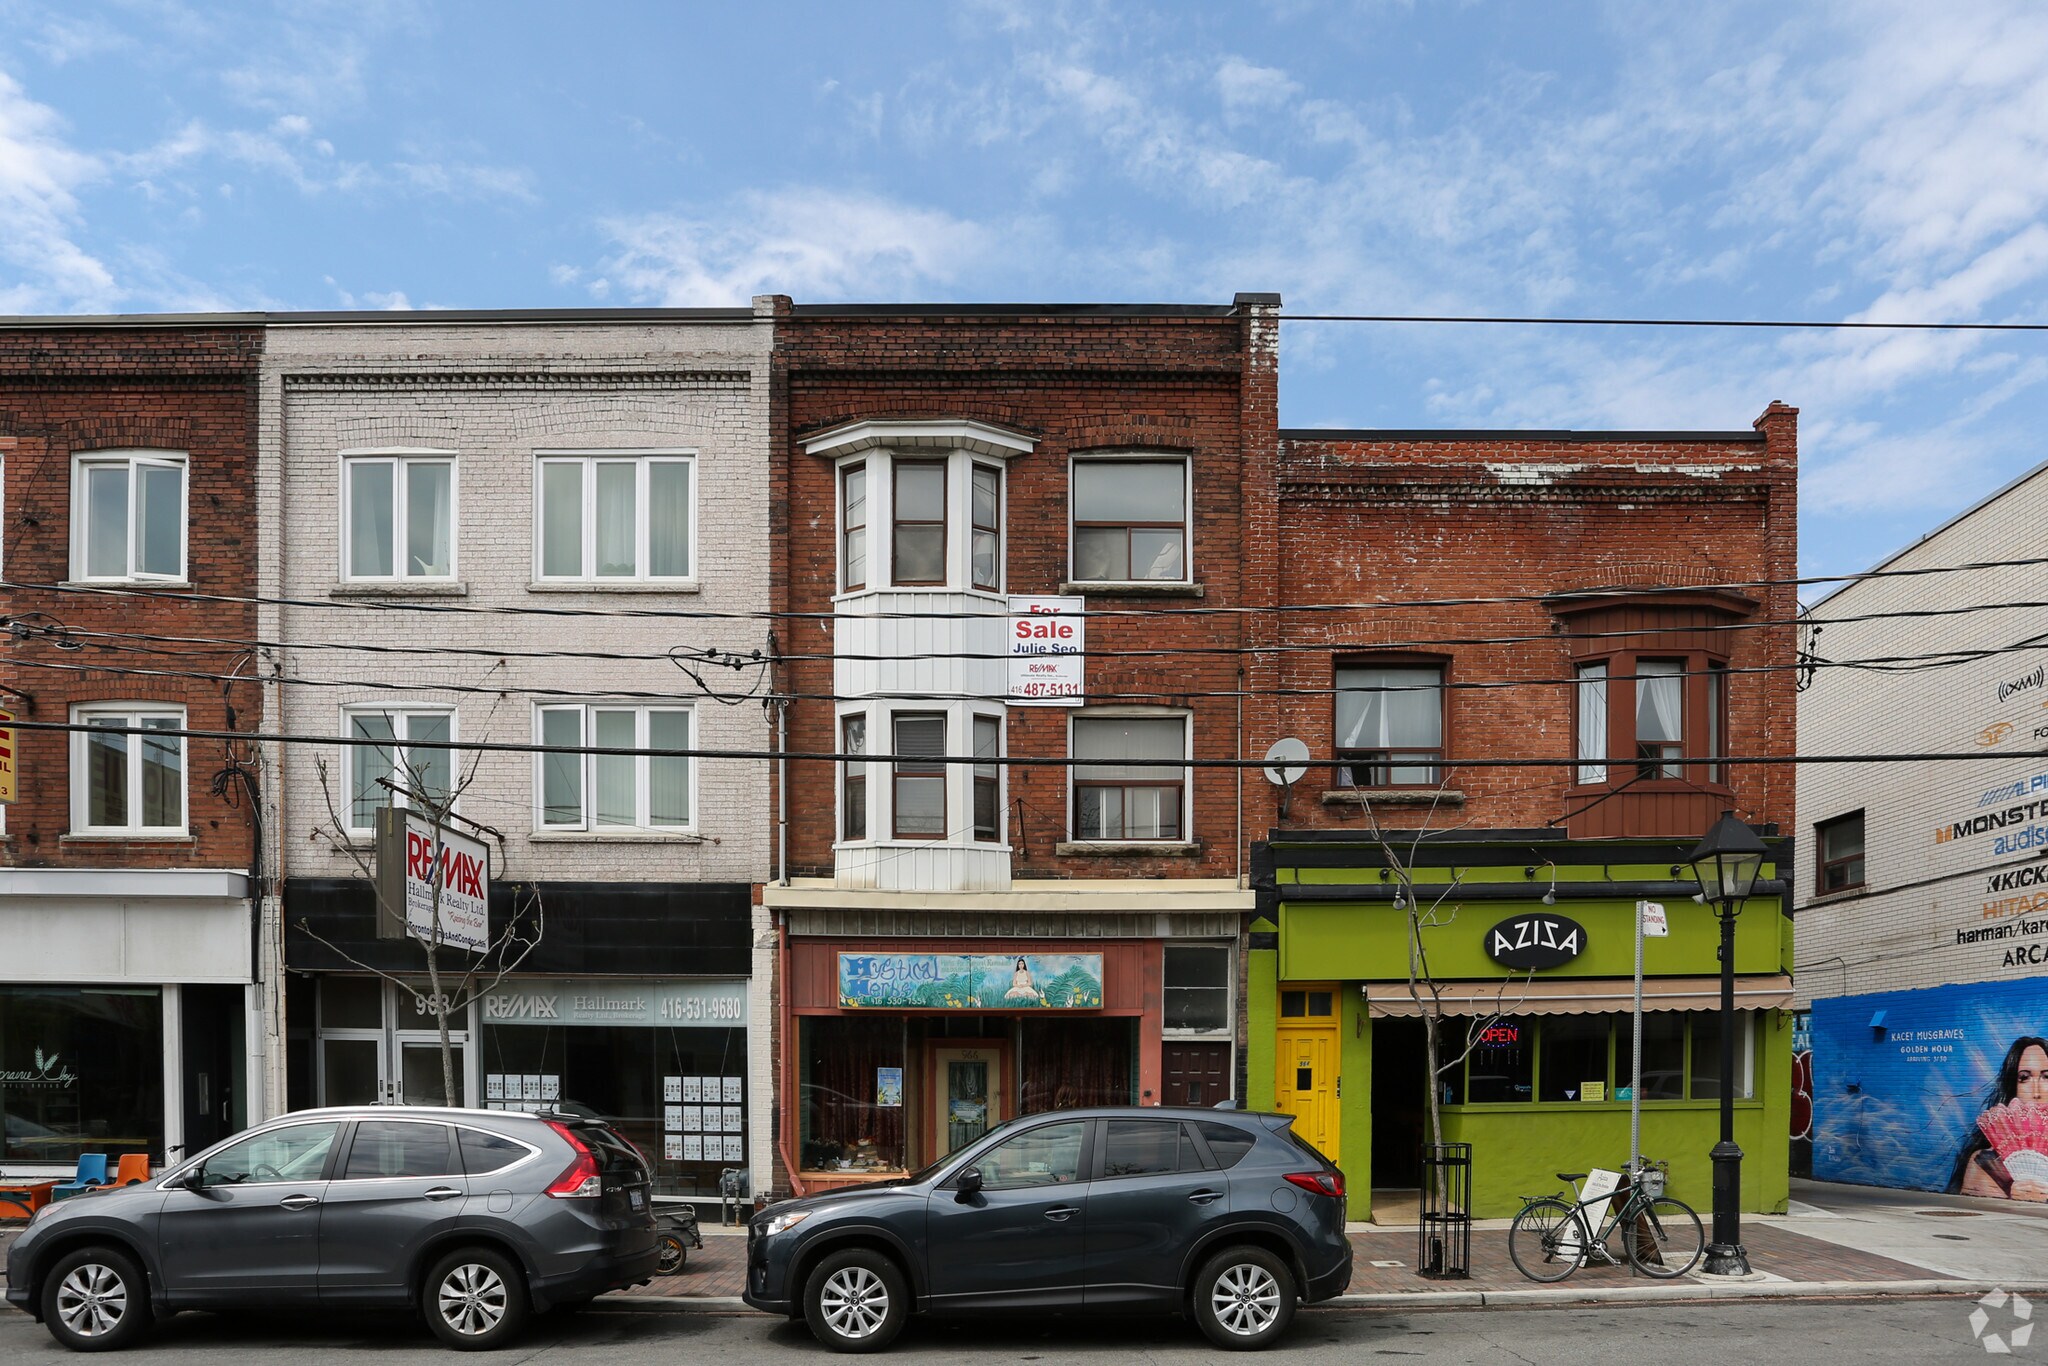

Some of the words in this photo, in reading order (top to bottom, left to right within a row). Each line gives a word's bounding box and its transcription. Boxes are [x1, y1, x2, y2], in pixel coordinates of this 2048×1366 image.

[1016, 620, 1073, 638] Sale
[1013, 643, 1046, 654] Julie
[1051, 643, 1077, 654] Seo
[1029, 664, 1057, 673] RE/MAX
[1024, 683, 1079, 697] 487-5131
[2001, 864, 2048, 891] KICK
[446, 893, 469, 914] Realty
[470, 900, 486, 916] Ltd.
[1647, 905, 1656, 913] NO
[1643, 915, 1665, 924] STANDING
[1494, 920, 1578, 957] AZIZA
[1956, 919, 2048, 945] harman/kar
[847, 979, 913, 998] Herbs
[485, 994, 559, 1018] RE/MAX
[573, 996, 646, 1010] Hallmark
[661, 997, 741, 1019] 416-531-9680
[1480, 1029, 1518, 1042] OPEN
[1891, 1032, 1914, 1041] KACEY
[1916, 1029, 1965, 1040] MUSGRAVES
[1931, 1045, 1953, 1053] HOUR
